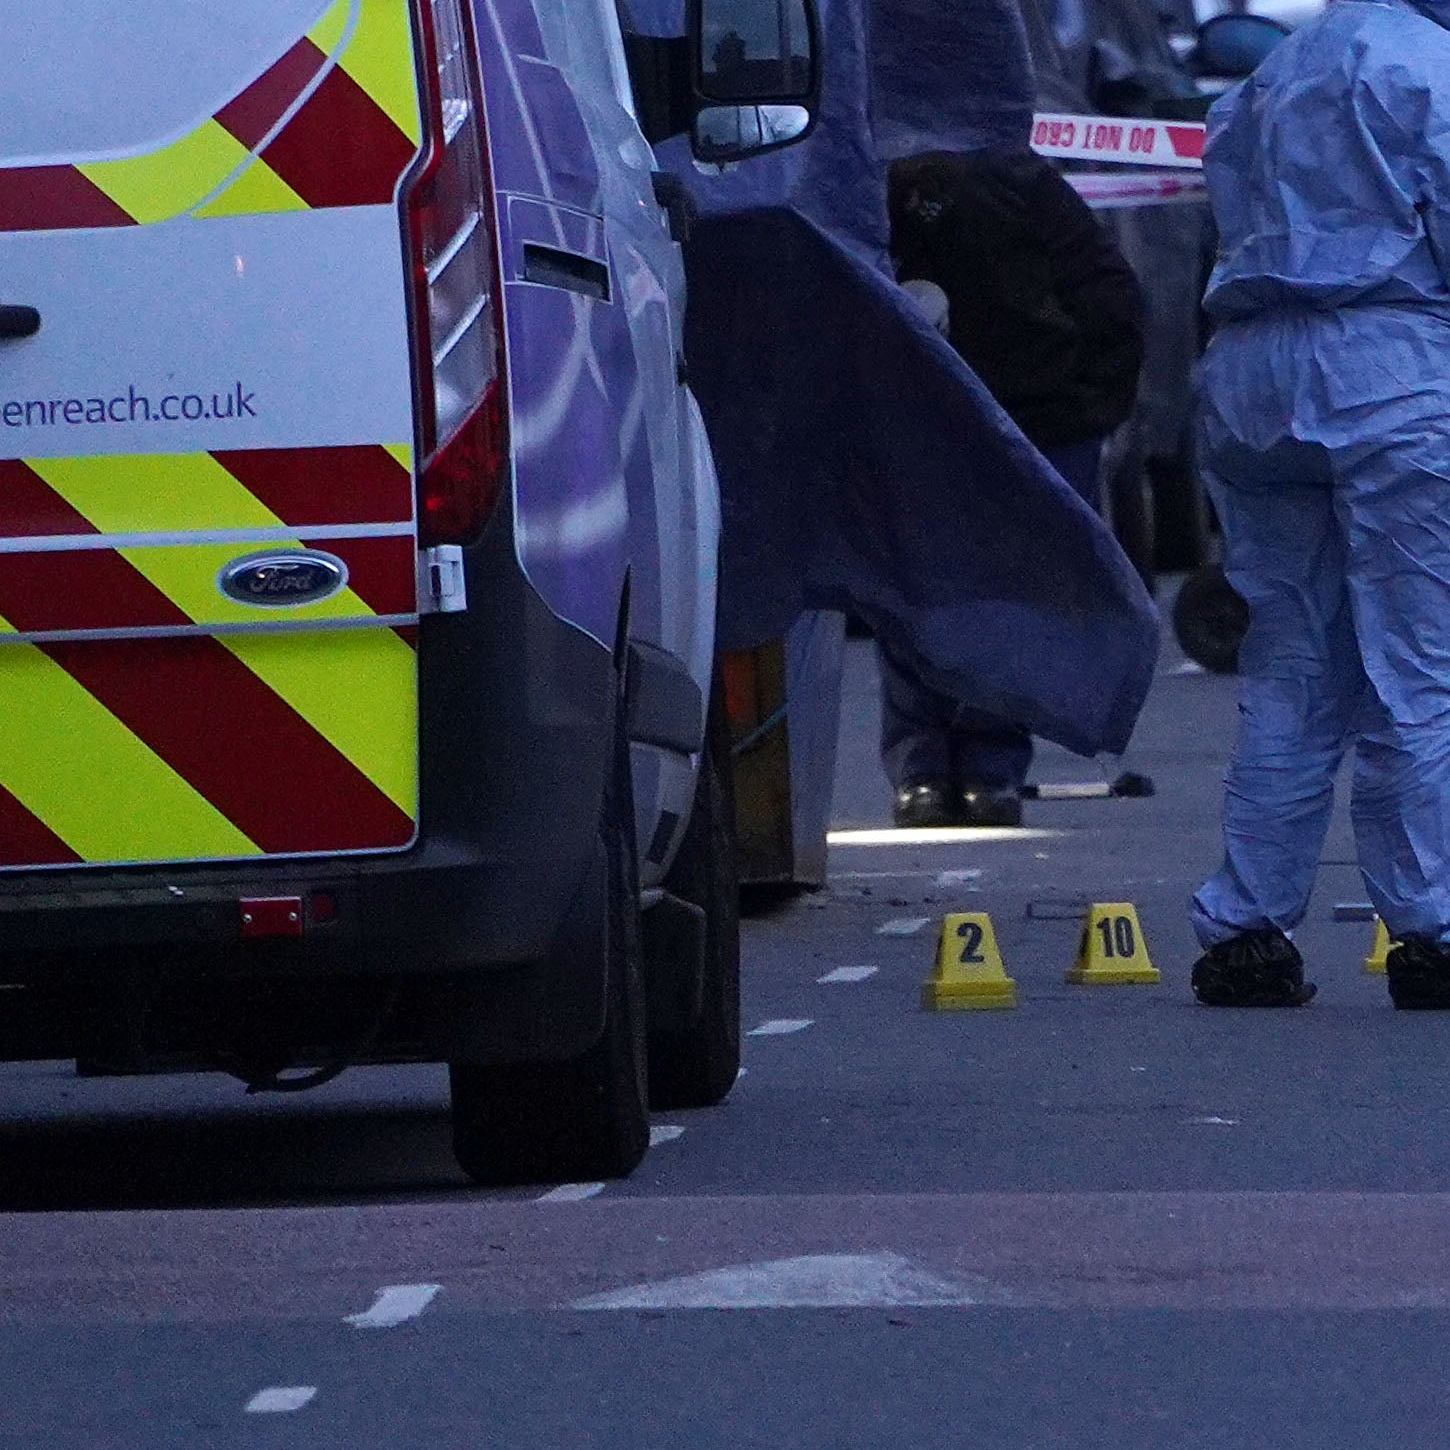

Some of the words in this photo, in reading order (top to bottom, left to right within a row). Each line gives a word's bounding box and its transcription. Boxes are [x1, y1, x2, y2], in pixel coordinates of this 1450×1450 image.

[1083, 125, 1121, 150] NOT
[1130, 127, 1155, 153] DO
[2, 381, 257, 428] enreach.co.uk
[248, 563, 318, 593] Ford
[956, 922, 985, 964] 2
[1095, 916, 1136, 960] 10
